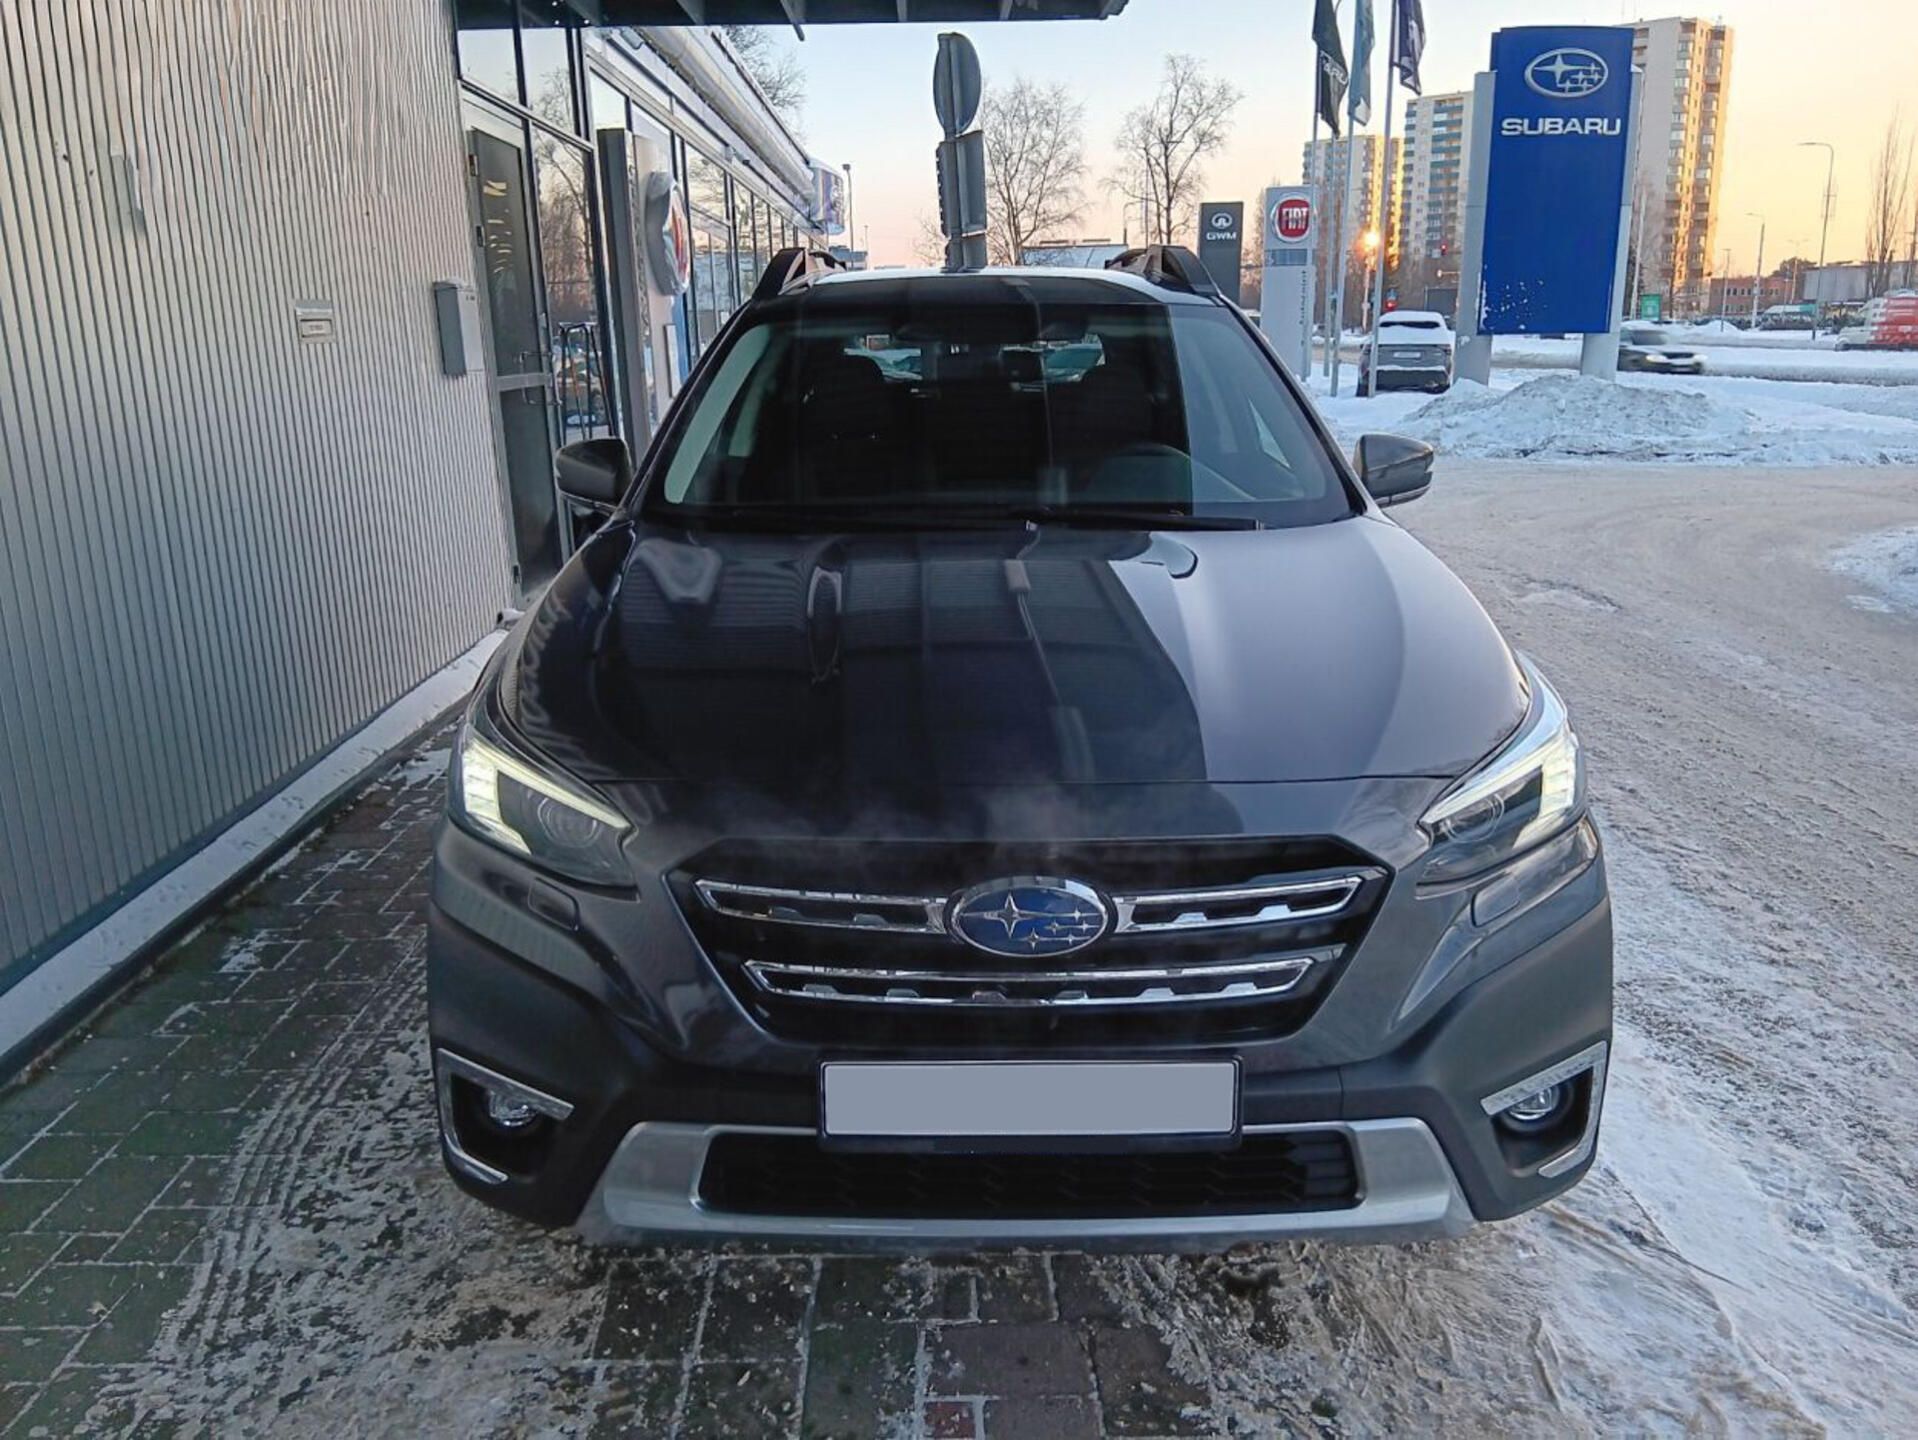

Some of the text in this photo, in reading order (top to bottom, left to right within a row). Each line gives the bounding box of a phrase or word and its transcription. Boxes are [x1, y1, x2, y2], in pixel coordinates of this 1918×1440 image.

[1501, 118, 1621, 136] SUBARU
[1282, 207, 1308, 230] FIAT
[1206, 232, 1237, 240] GWM
